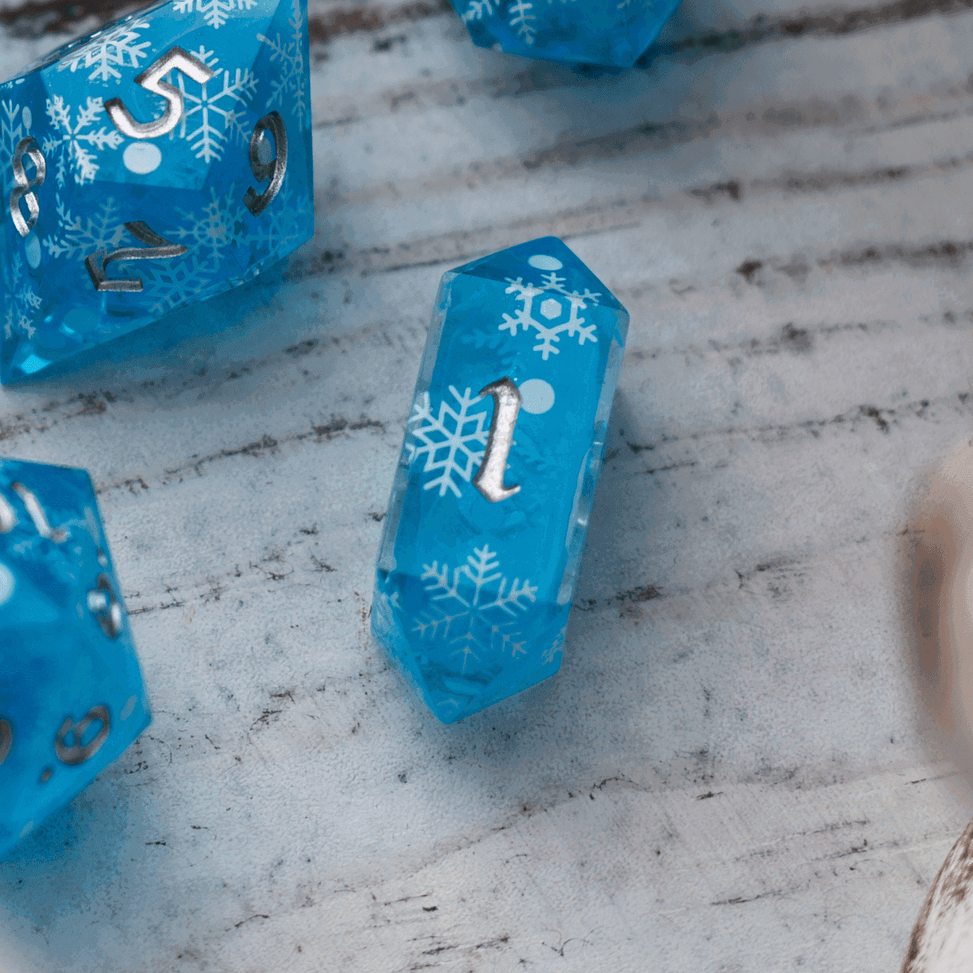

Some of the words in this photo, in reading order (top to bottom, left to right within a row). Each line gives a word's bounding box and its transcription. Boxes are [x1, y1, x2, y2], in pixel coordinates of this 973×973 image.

[104, 46, 213, 139] 5
[10, 136, 46, 237] 8
[243, 110, 288, 216] 9
[472, 375, 522, 503] 1
